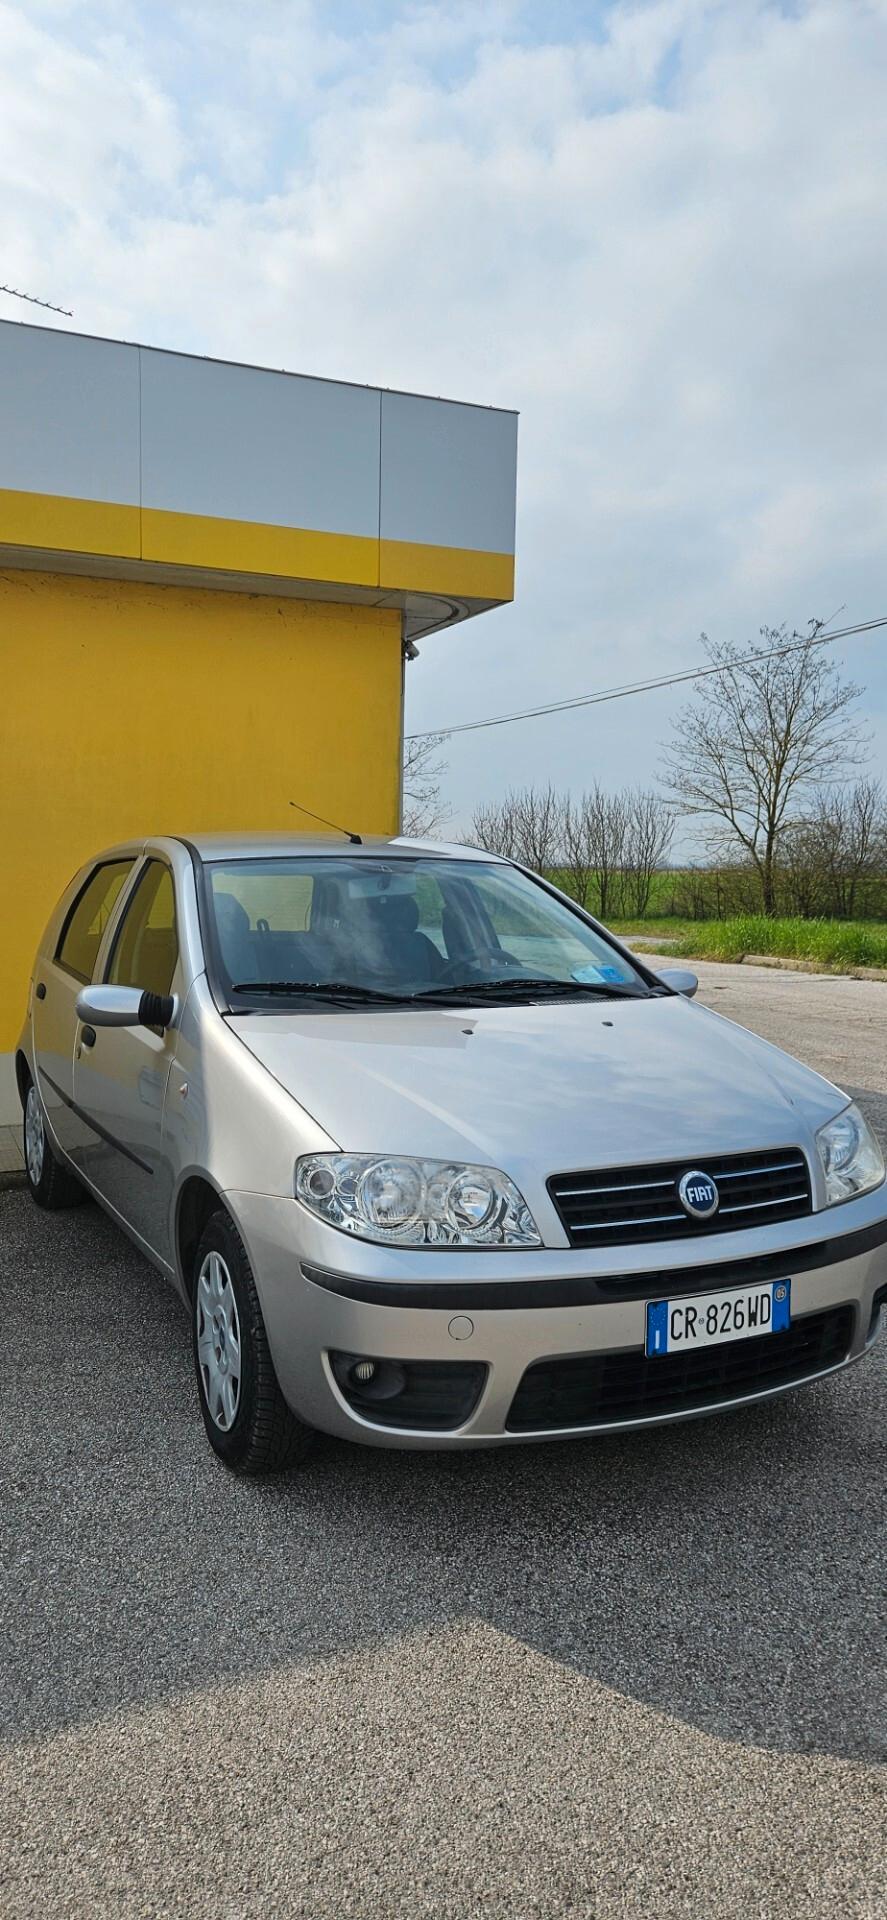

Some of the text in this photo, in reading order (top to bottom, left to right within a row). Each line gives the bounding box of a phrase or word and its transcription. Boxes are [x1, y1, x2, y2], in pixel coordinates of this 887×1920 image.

[687, 1185, 712, 1203] FIAT
[670, 1294, 771, 1341] CR 826WD
[655, 1330, 661, 1349] I
